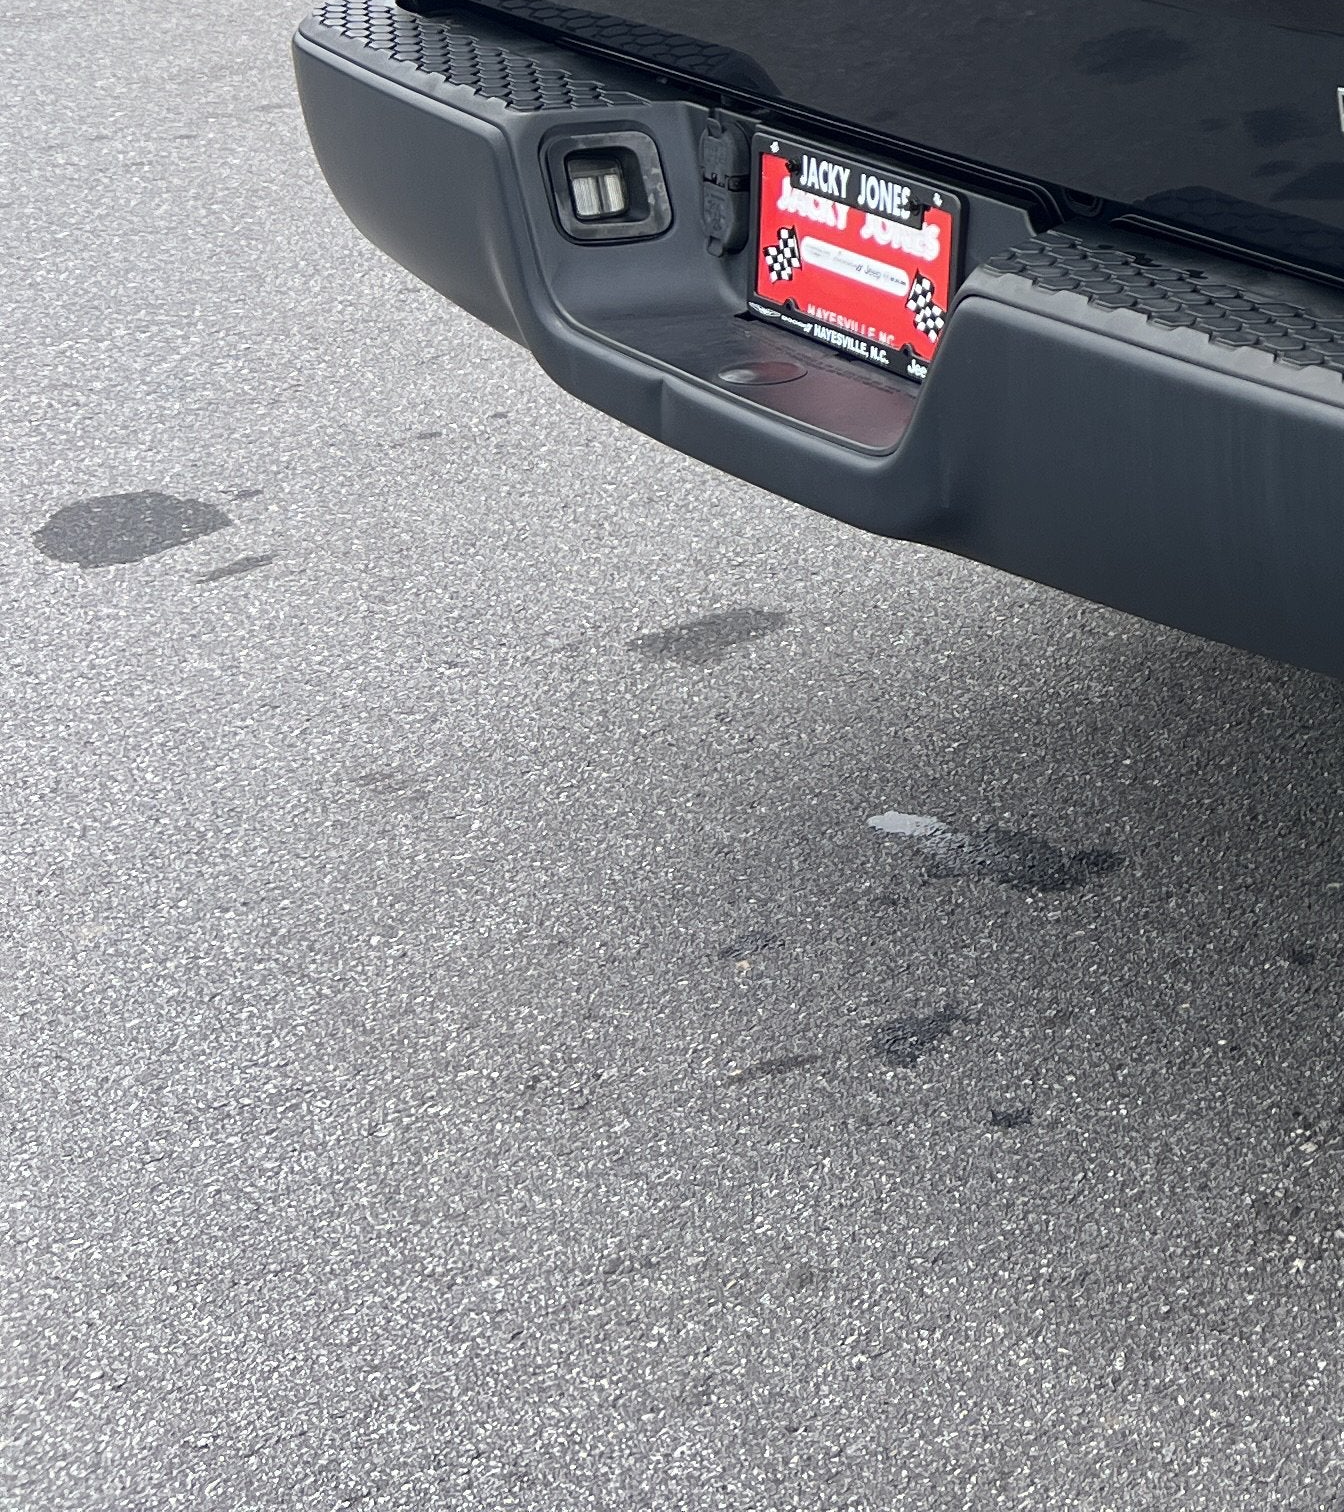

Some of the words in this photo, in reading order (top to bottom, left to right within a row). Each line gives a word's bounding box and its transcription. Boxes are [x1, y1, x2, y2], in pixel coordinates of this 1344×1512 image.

[799, 154, 850, 199] JACKY
[857, 173, 911, 220] JONES
[807, 303, 876, 338] HAYESVILLE
